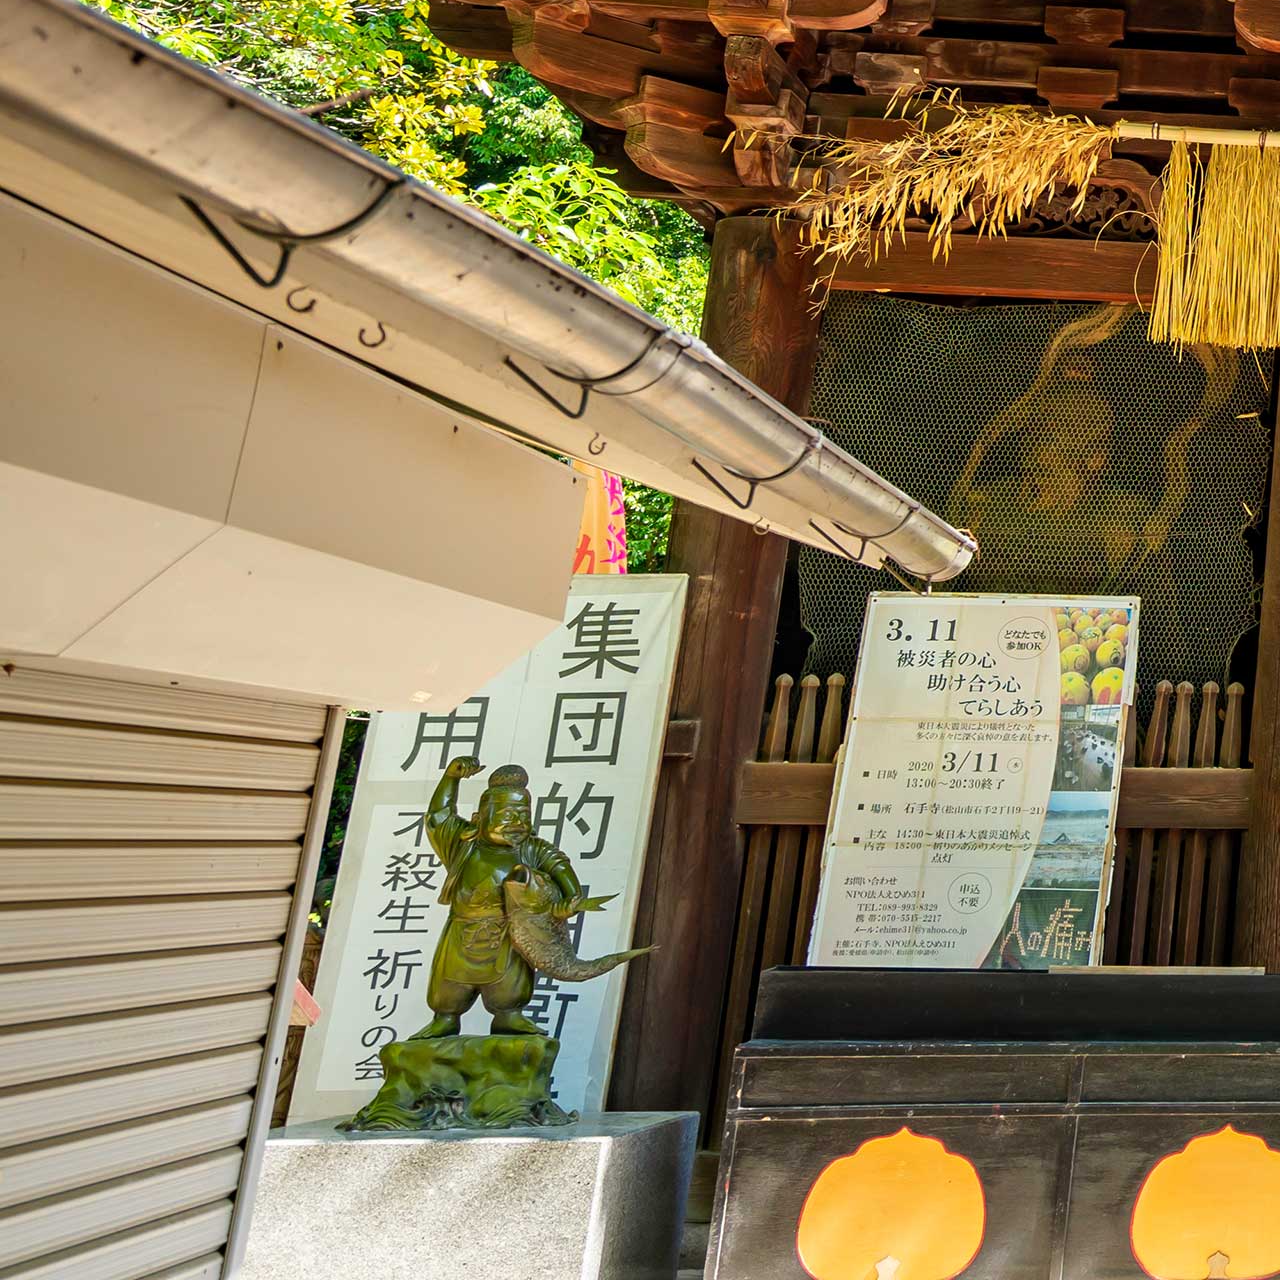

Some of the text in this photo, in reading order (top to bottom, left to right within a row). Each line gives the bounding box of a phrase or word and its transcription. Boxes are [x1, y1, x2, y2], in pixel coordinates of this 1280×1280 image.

[1003, 629, 1047, 640] どなたでも
[1006, 641, 1043, 651] 参加OK
[897, 649, 997, 669] 被災者の心
[927, 673, 1021, 694] 助け合う心
[958, 698, 1044, 717] てらしあう
[876, 770, 898, 780] 日時
[908, 761, 934, 771] 2020
[941, 750, 1000, 774] 3/11
[870, 802, 893, 814] 場所
[867, 829, 887, 840] 主な
[863, 842, 885, 851] 内容
[931, 853, 954, 864] 点灯
[844, 876, 898, 886] お問い合わせ
[959, 883, 981, 895] 申込
[957, 897, 979, 907] 不要
